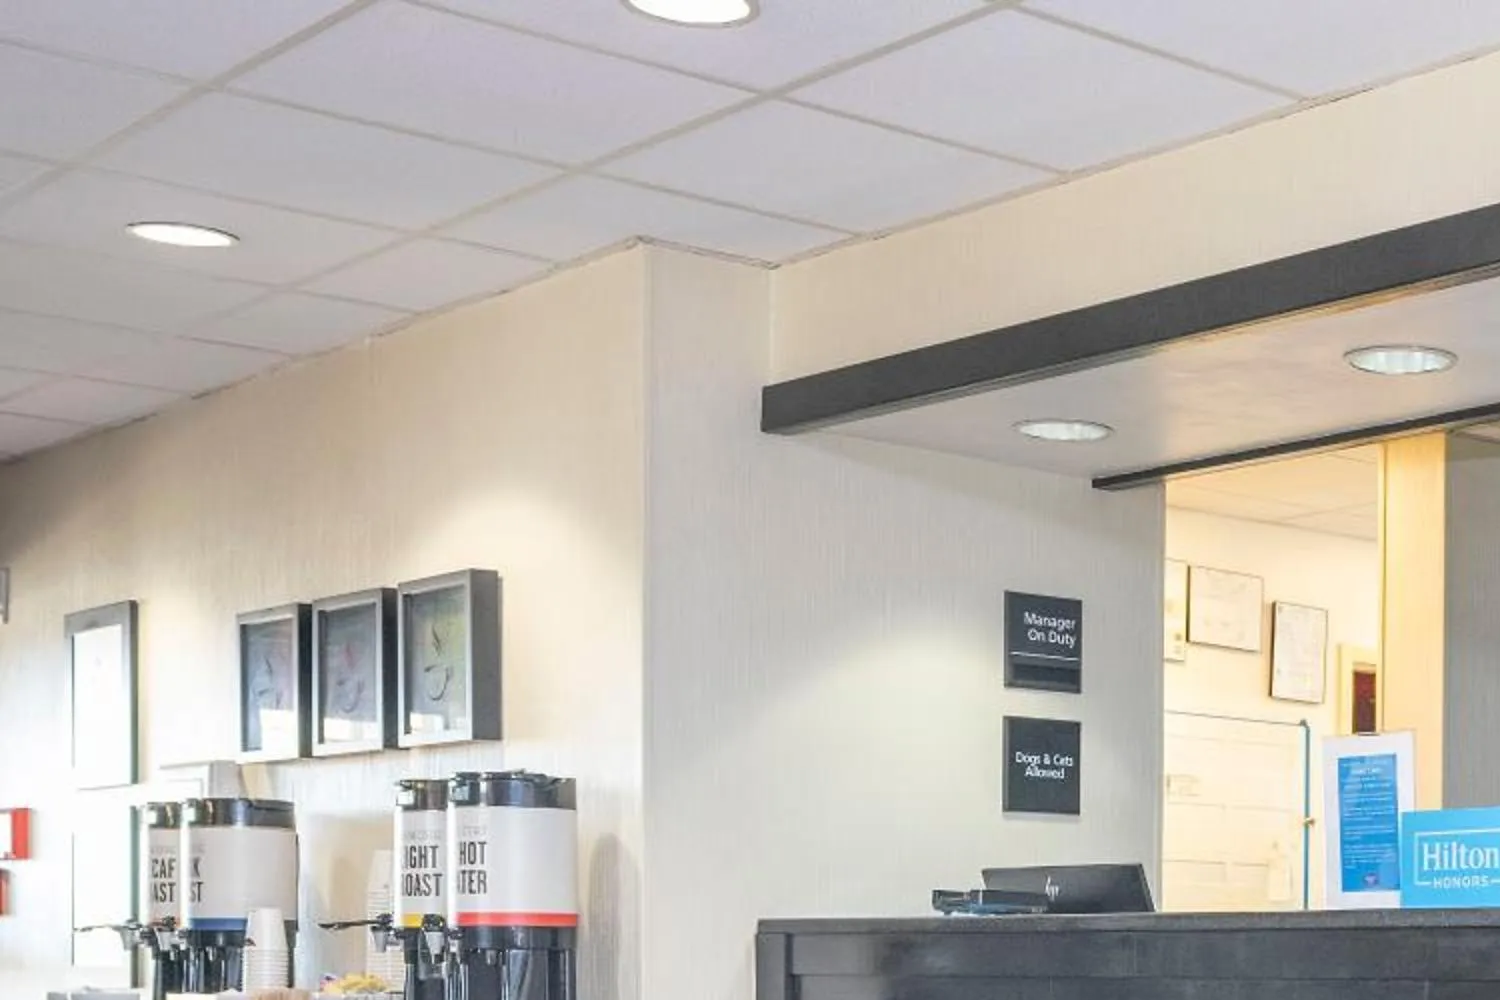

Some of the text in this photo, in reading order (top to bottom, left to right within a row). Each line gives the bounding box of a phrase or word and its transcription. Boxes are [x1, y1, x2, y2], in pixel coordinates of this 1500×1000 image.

[1024, 611, 1076, 631] Manager
[1028, 629, 1076, 648] On Duty
[1015, 751, 1040, 767] Dogs
[1024, 766, 1065, 779] Allowed
[403, 845, 439, 869] IGHT
[459, 841, 487, 865] HOT
[1423, 841, 1500, 872] Hilton
[402, 873, 443, 897] OAST
[1433, 875, 1490, 889] HONORS
